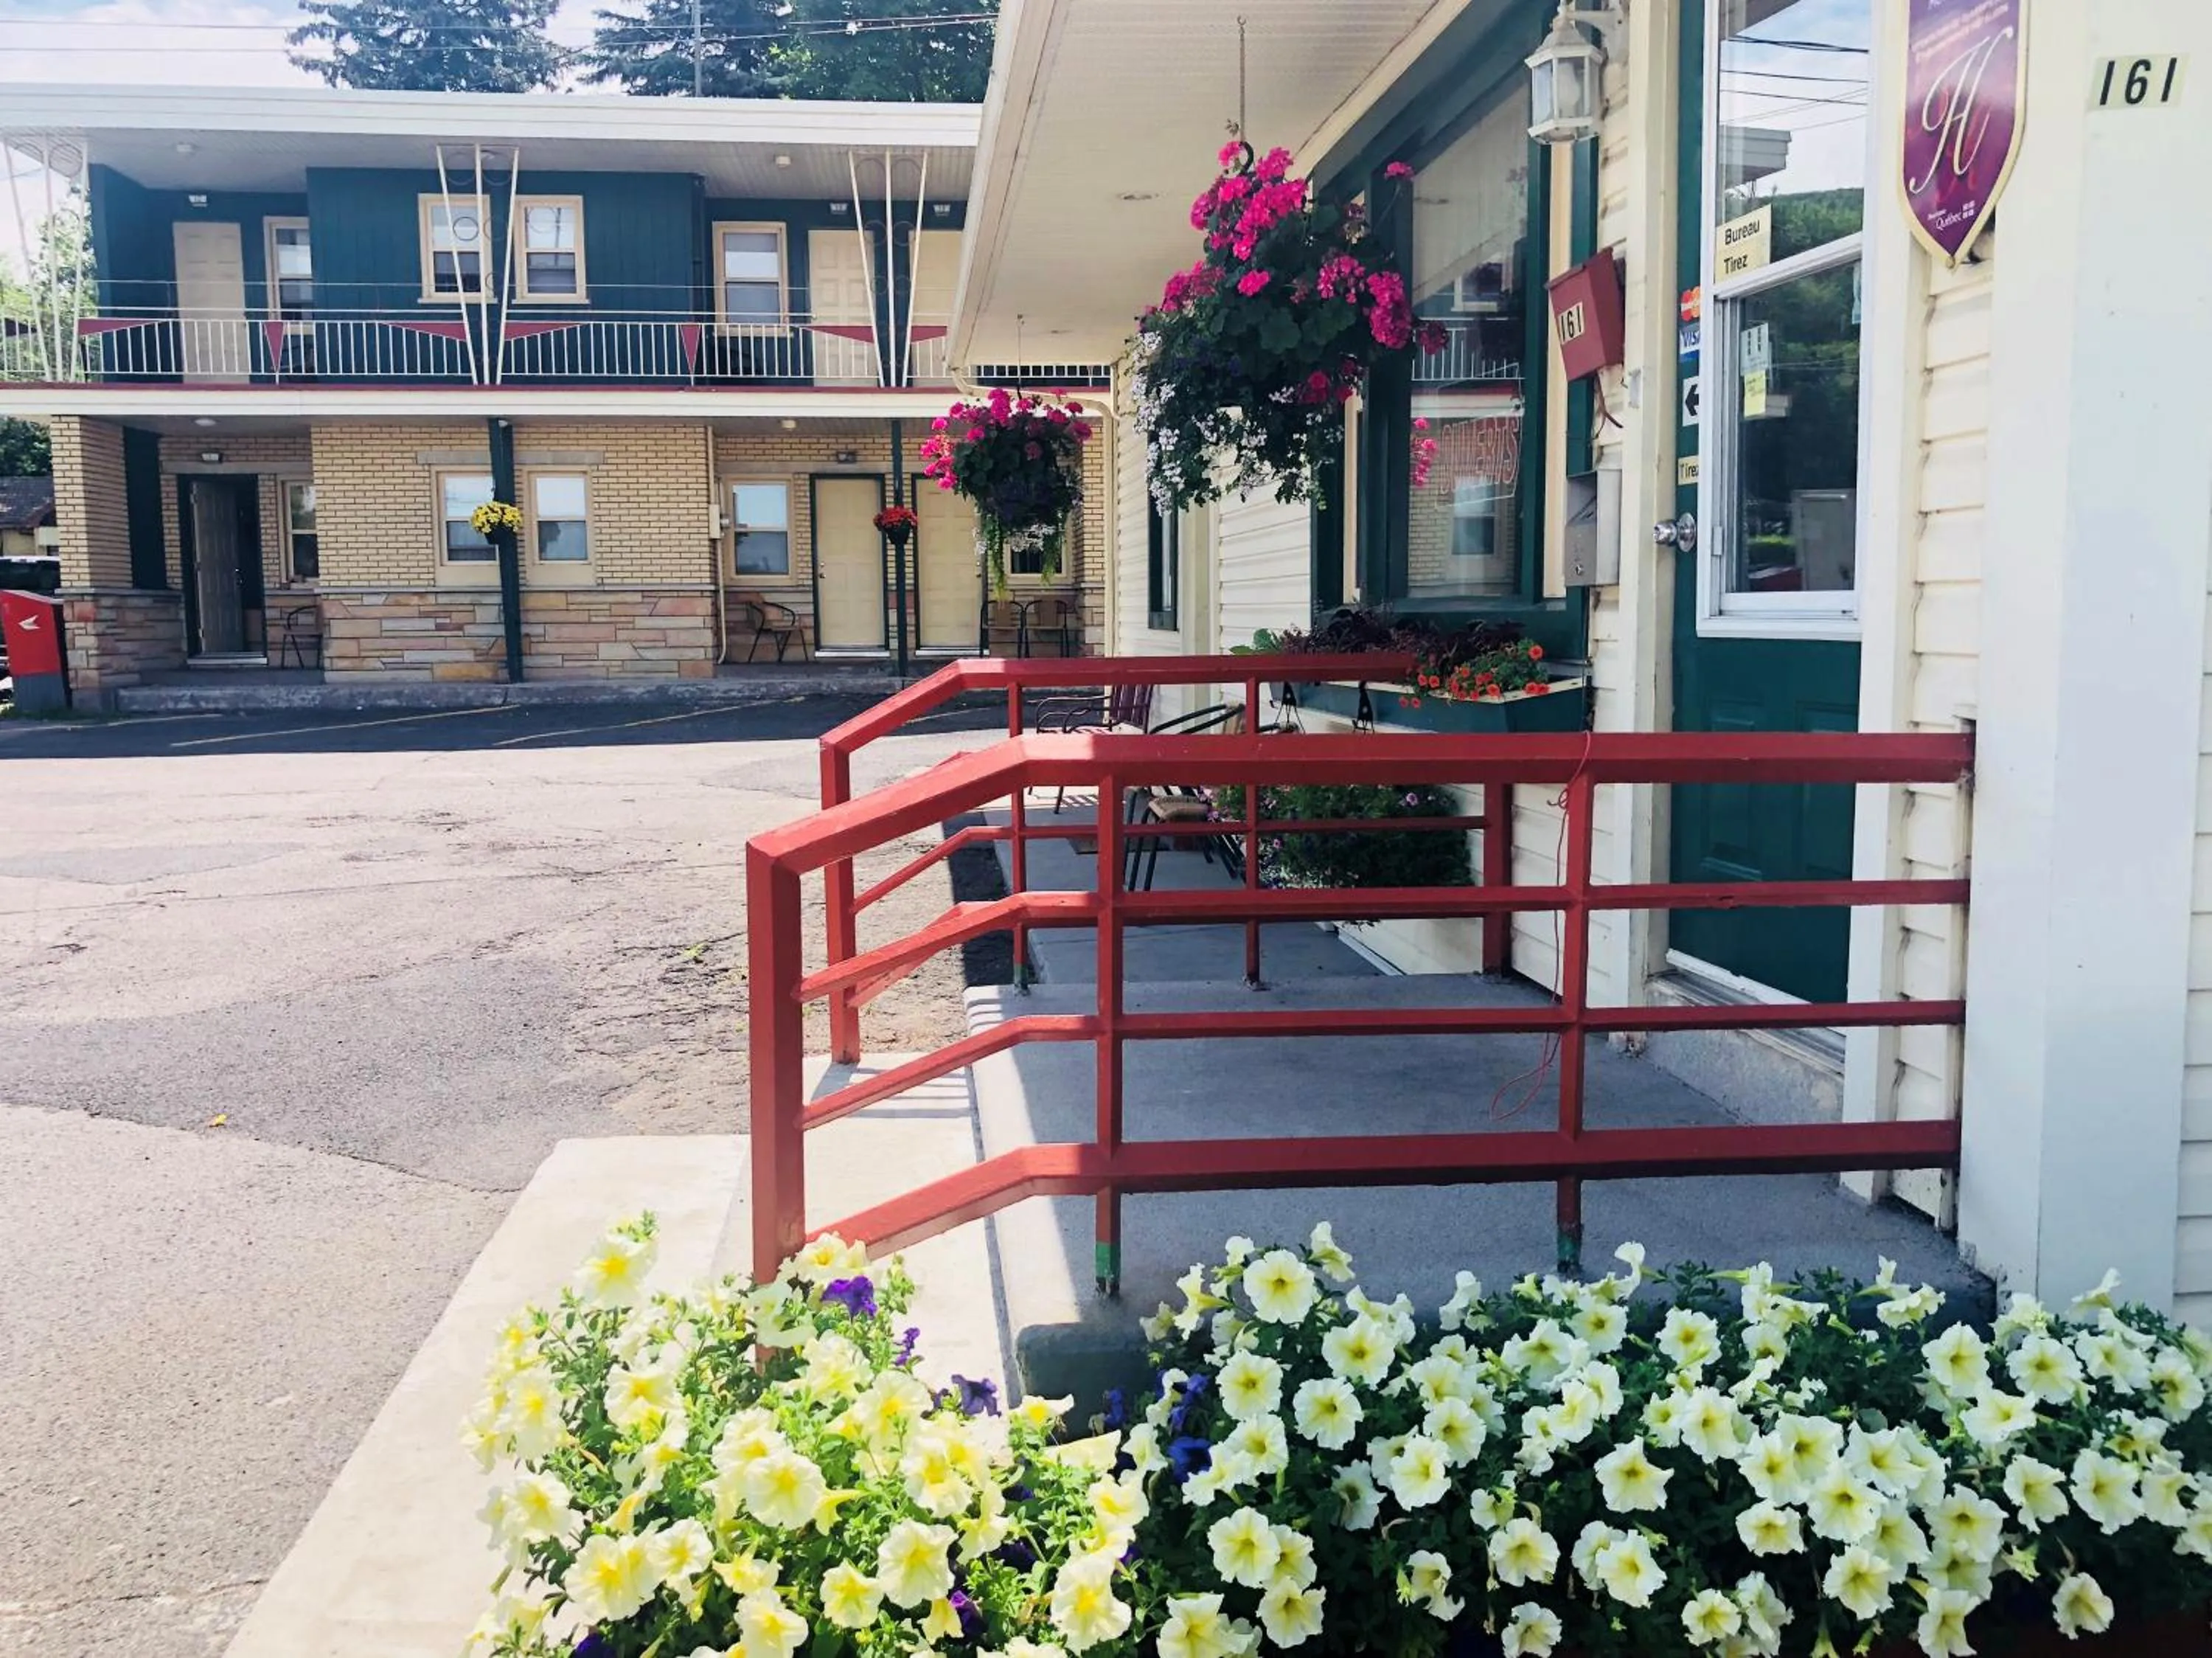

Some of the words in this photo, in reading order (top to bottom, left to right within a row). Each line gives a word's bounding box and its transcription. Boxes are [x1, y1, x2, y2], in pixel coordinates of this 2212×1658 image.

[2099, 57, 2177, 106] 161
[1725, 220, 1760, 246] Bureau
[1724, 254, 1747, 274] Tirez
[1561, 305, 1582, 341] 161
